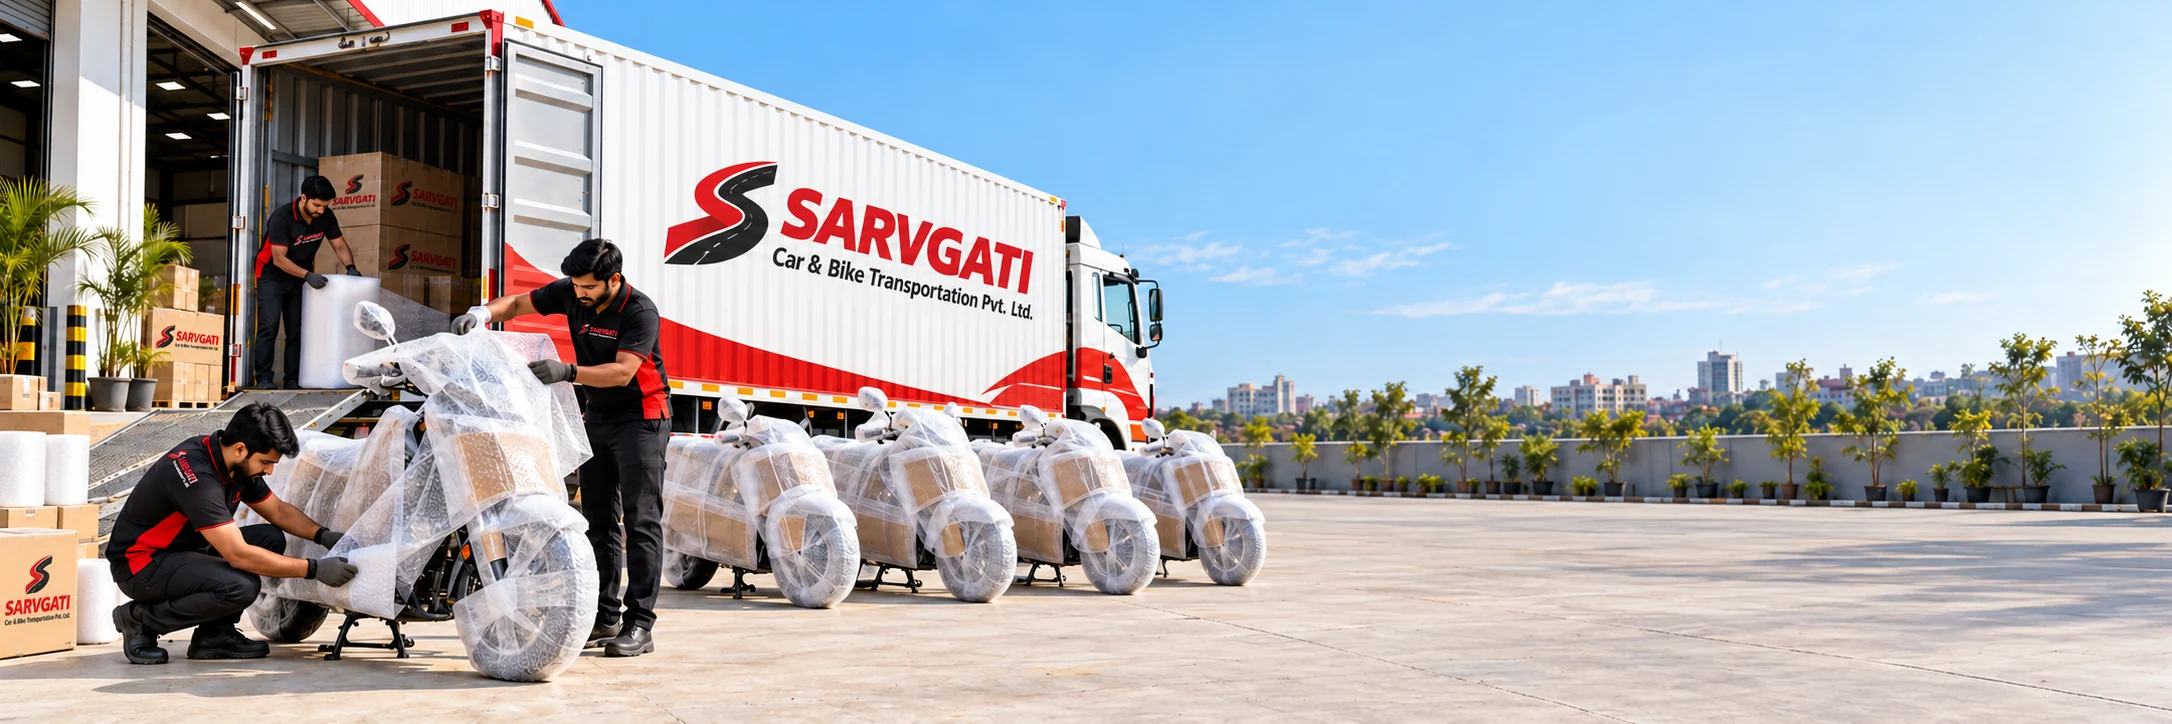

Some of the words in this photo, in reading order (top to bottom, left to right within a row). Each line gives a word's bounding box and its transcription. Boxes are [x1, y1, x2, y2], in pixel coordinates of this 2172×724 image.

[412, 188, 459, 207] SARVGATI
[780, 188, 1034, 294] SARVGATI
[411, 250, 457, 269] SARVGATI
[772, 247, 805, 271] Car
[807, 254, 822, 275] &
[828, 258, 865, 284] Bike
[869, 267, 978, 308] Transportation
[981, 294, 1006, 314] Pvt.
[1011, 301, 1033, 320] Ltd.
[176, 331, 219, 345] SARVGATI
[5, 595, 70, 616] SARVGATI
